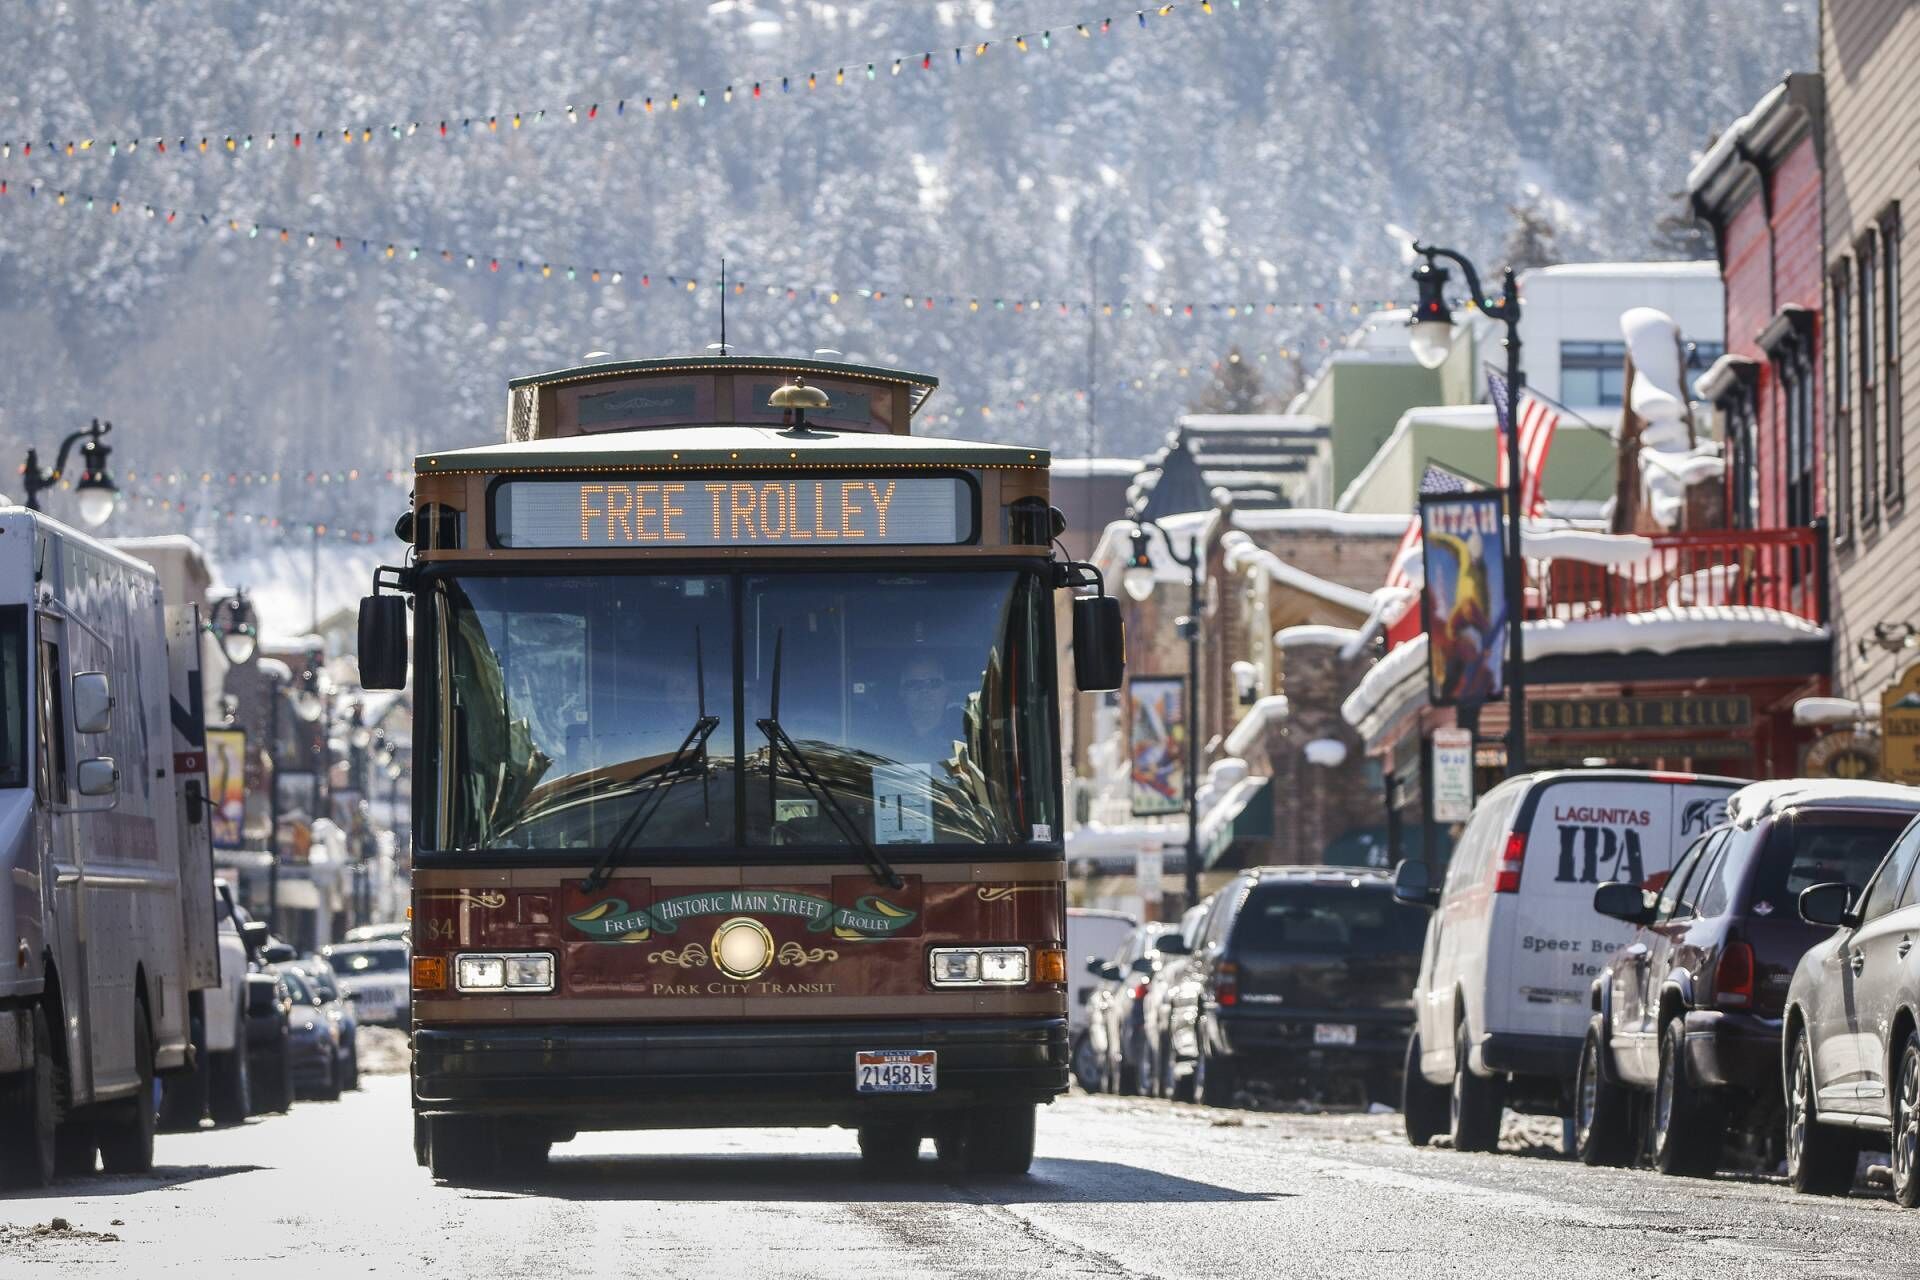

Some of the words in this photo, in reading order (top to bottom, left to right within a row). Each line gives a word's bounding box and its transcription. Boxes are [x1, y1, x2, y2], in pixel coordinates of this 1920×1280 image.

[579, 484, 686, 540] FREE
[704, 482, 896, 539] TROLLEY
[1428, 503, 1497, 534] UTAH
[1543, 702, 1645, 727] ROBERT
[1554, 806, 1650, 826] LAGUNITAS
[1554, 824, 1644, 884] IPA
[604, 915, 647, 933] FREE
[661, 896, 724, 920] HISTORIC
[730, 893, 767, 911] MAIN
[773, 894, 823, 918] STREET
[841, 910, 890, 930] TROLLEY
[1523, 935, 1582, 953] Speer
[1572, 962, 1602, 977] Me
[653, 983, 700, 995] PARK
[707, 982, 749, 994] CITY
[758, 982, 835, 994] TRANSIT
[863, 1065, 920, 1086] 214581
